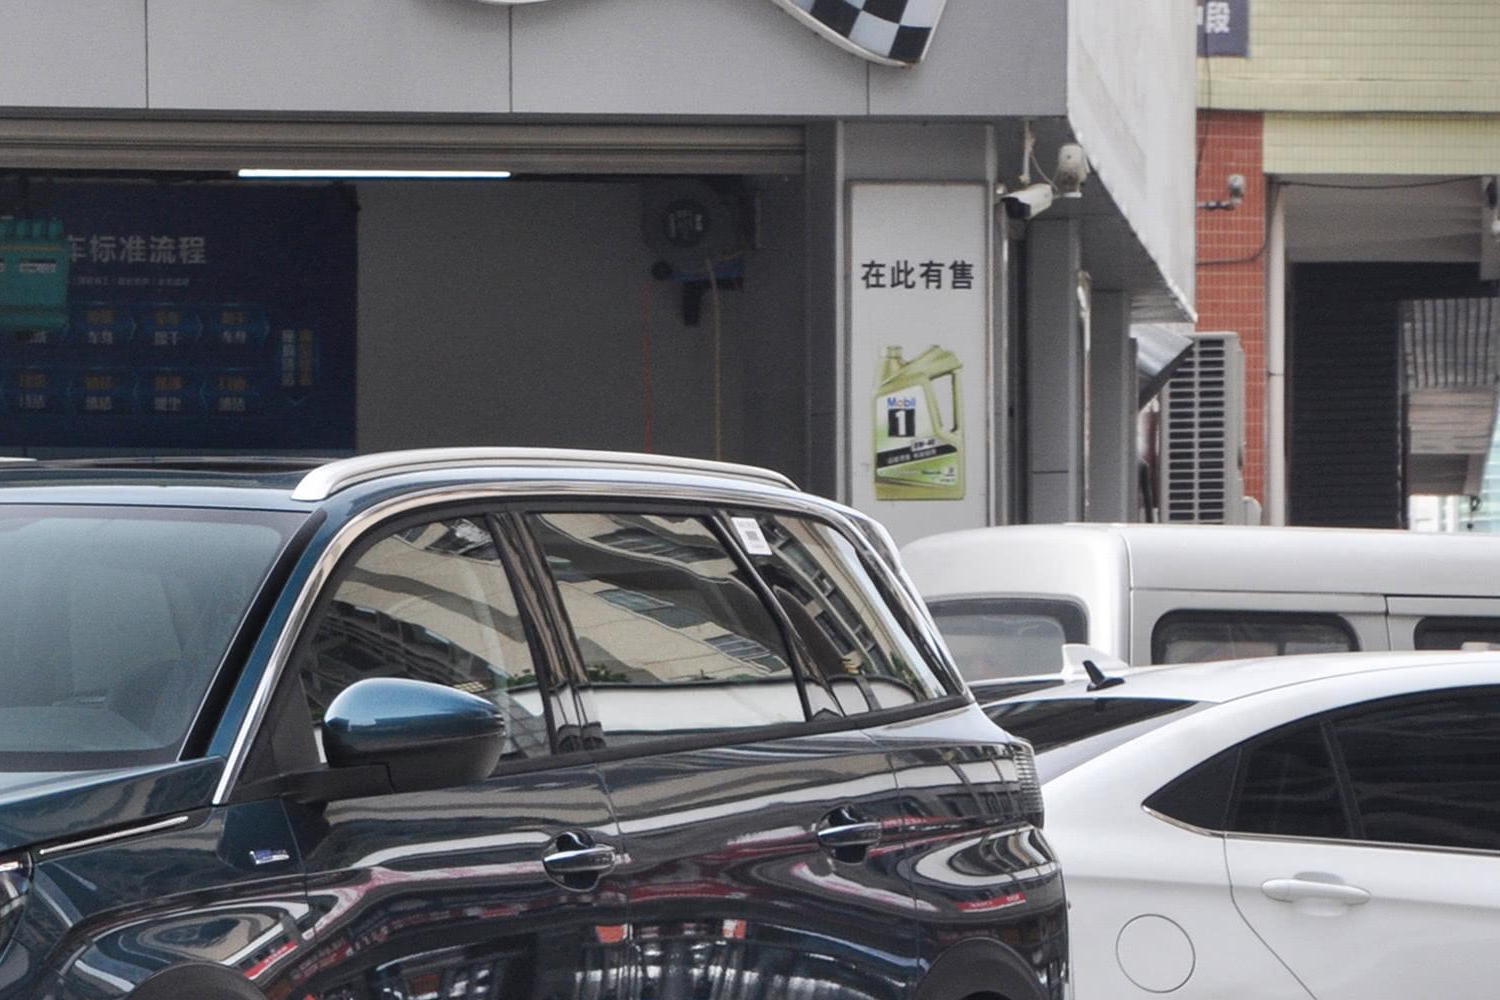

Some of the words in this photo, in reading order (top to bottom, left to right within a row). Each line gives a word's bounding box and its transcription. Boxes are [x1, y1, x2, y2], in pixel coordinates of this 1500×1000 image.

[860, 260, 975, 291] 在此有售
[887, 396, 916, 408] Mobil
[895, 410, 906, 436] 1
